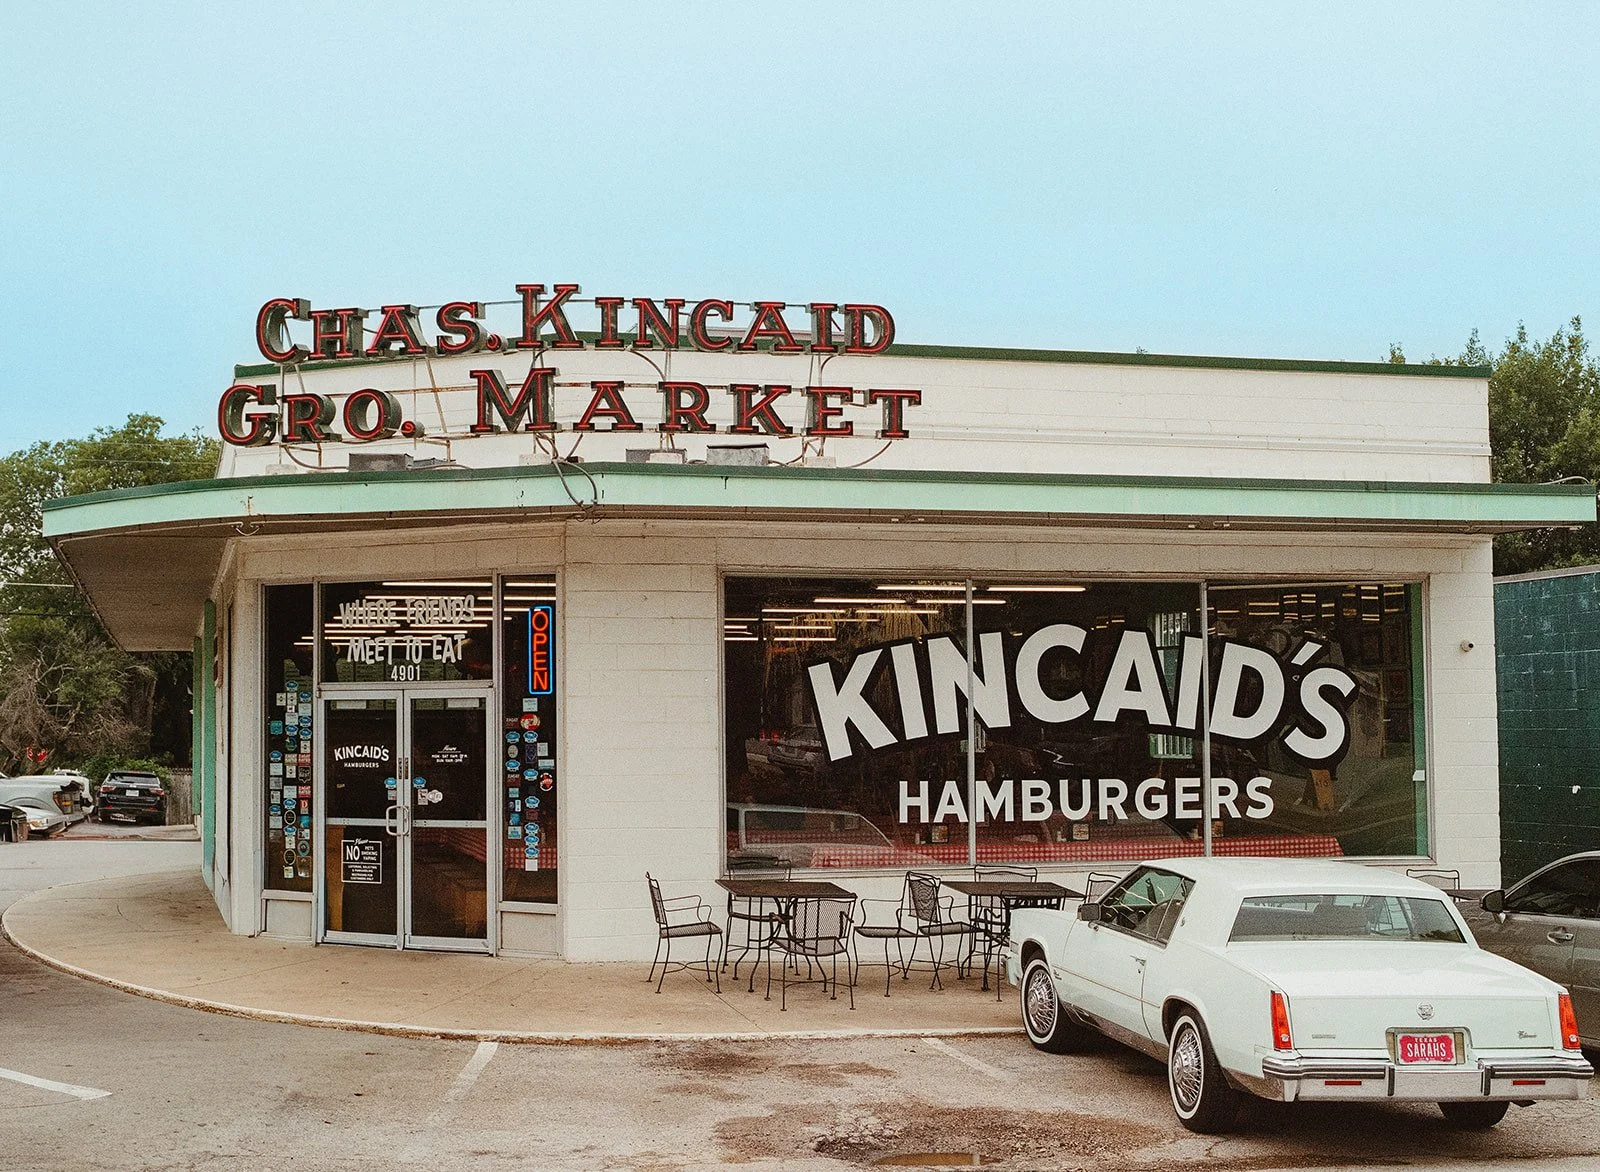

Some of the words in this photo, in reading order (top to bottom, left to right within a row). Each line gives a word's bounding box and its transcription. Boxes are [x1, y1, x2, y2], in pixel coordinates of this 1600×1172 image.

[256, 297, 509, 362] CHAS.
[515, 283, 896, 355] KINCAID
[218, 384, 423, 447] GRO.
[470, 367, 923, 439] MARKET
[339, 599, 398, 629] WHERE
[405, 594, 475, 626] FRIENDS
[347, 636, 396, 665] MEET
[403, 635, 423, 664] TO
[432, 634, 466, 664] EAT
[531, 610, 549, 690] OPEN
[391, 665, 421, 681] 4901
[808, 623, 1357, 762] KINCAID'S
[334, 745, 389, 762] KINCAID'S
[898, 776, 1275, 824] HAMBURGERS
[346, 845, 360, 861] NO
[1407, 1043, 1447, 1057] SARAHS
